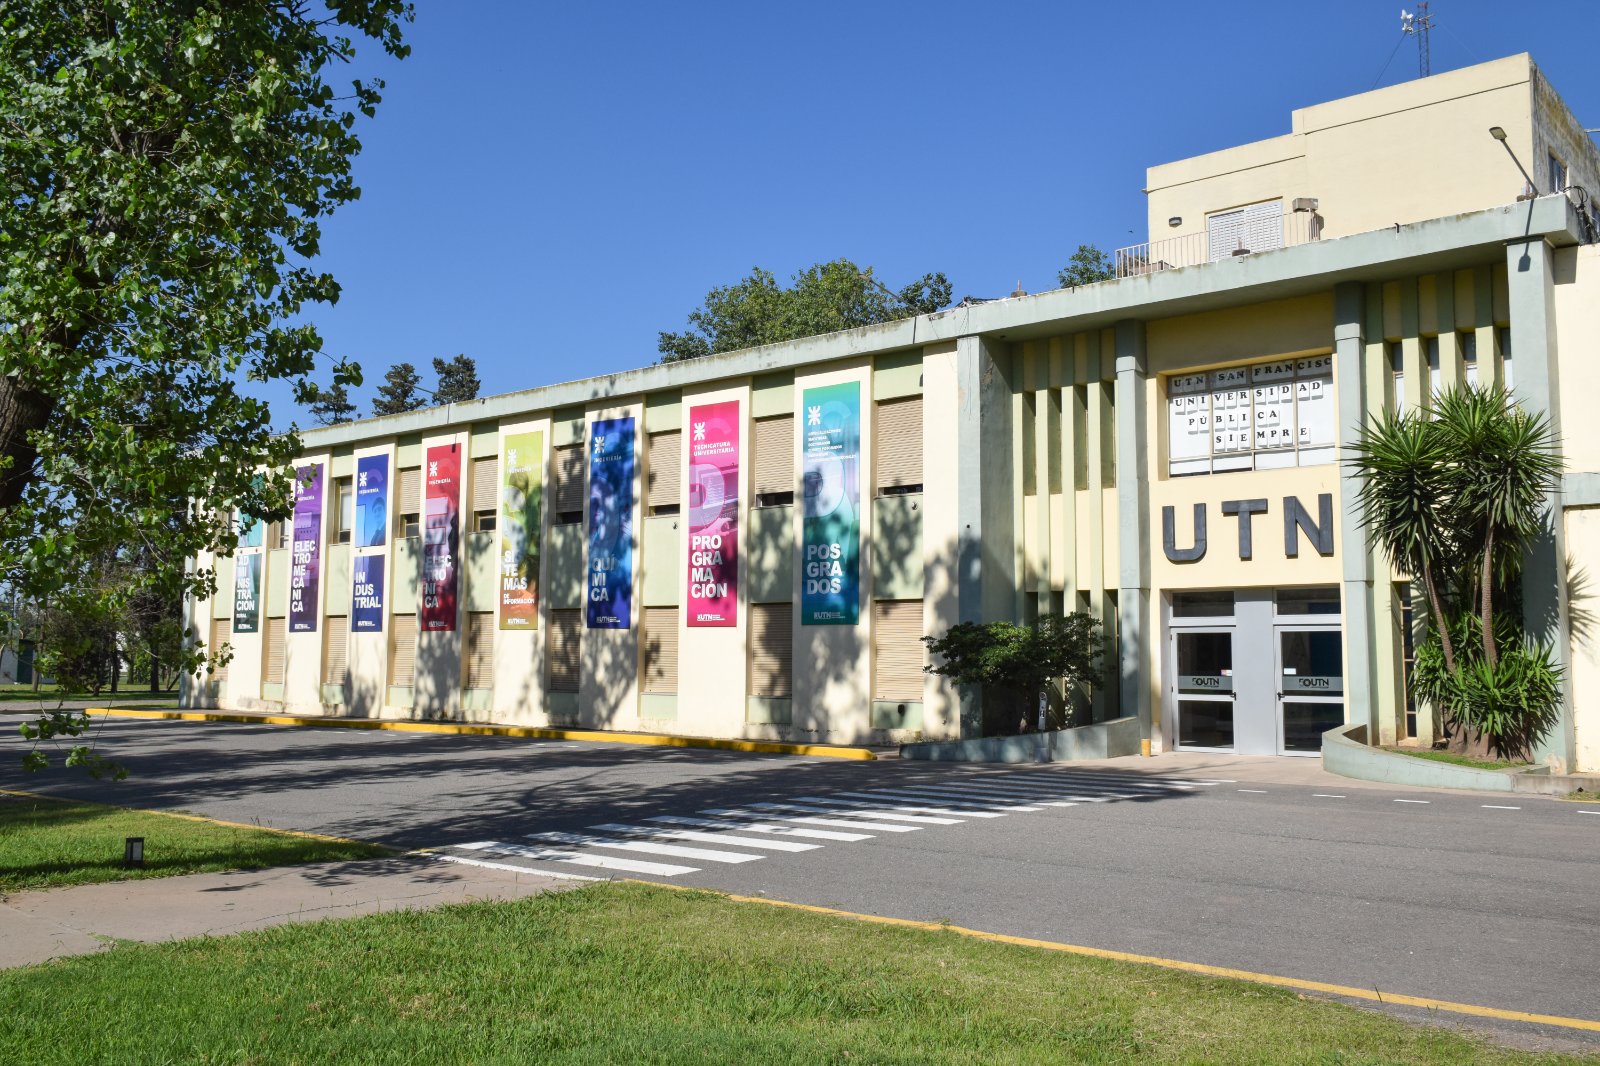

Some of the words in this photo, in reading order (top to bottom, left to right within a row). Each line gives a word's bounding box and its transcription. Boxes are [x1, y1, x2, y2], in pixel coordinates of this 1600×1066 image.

[1173, 376, 1204, 388] UTN
[1218, 370, 1245, 381] SAN
[1175, 381, 1321, 407] UNIVERSIDAD
[1188, 410, 1278, 426] PÚBLICA
[1215, 427, 1307, 444] SIEMPRE
[693, 441, 731, 450] TECNICATURA
[693, 447, 735, 457] UNIVERSITARIA
[1162, 493, 1335, 562] UTN
[294, 541, 316, 553] ELEC
[692, 535, 722, 550] PRO
[807, 543, 841, 560] POS
[294, 553, 311, 564] TRO
[691, 551, 723, 566] GRA
[293, 565, 306, 577] ME
[504, 564, 518, 577] TE
[691, 568, 714, 582] MA
[807, 561, 842, 577] GRA
[237, 578, 250, 589] NIS
[355, 572, 366, 583] IN
[504, 577, 528, 590] MAS
[592, 573, 606, 586] MI
[355, 584, 374, 596] DUS
[425, 583, 436, 594] NI
[691, 580, 727, 599] CIÓN
[807, 578, 841, 595] DOS
[237, 589, 252, 600] TRA
[292, 589, 302, 600] NI
[591, 588, 609, 602] CA
[292, 601, 304, 612] CA
[355, 596, 381, 609] TRIAL
[425, 596, 439, 608] CA
